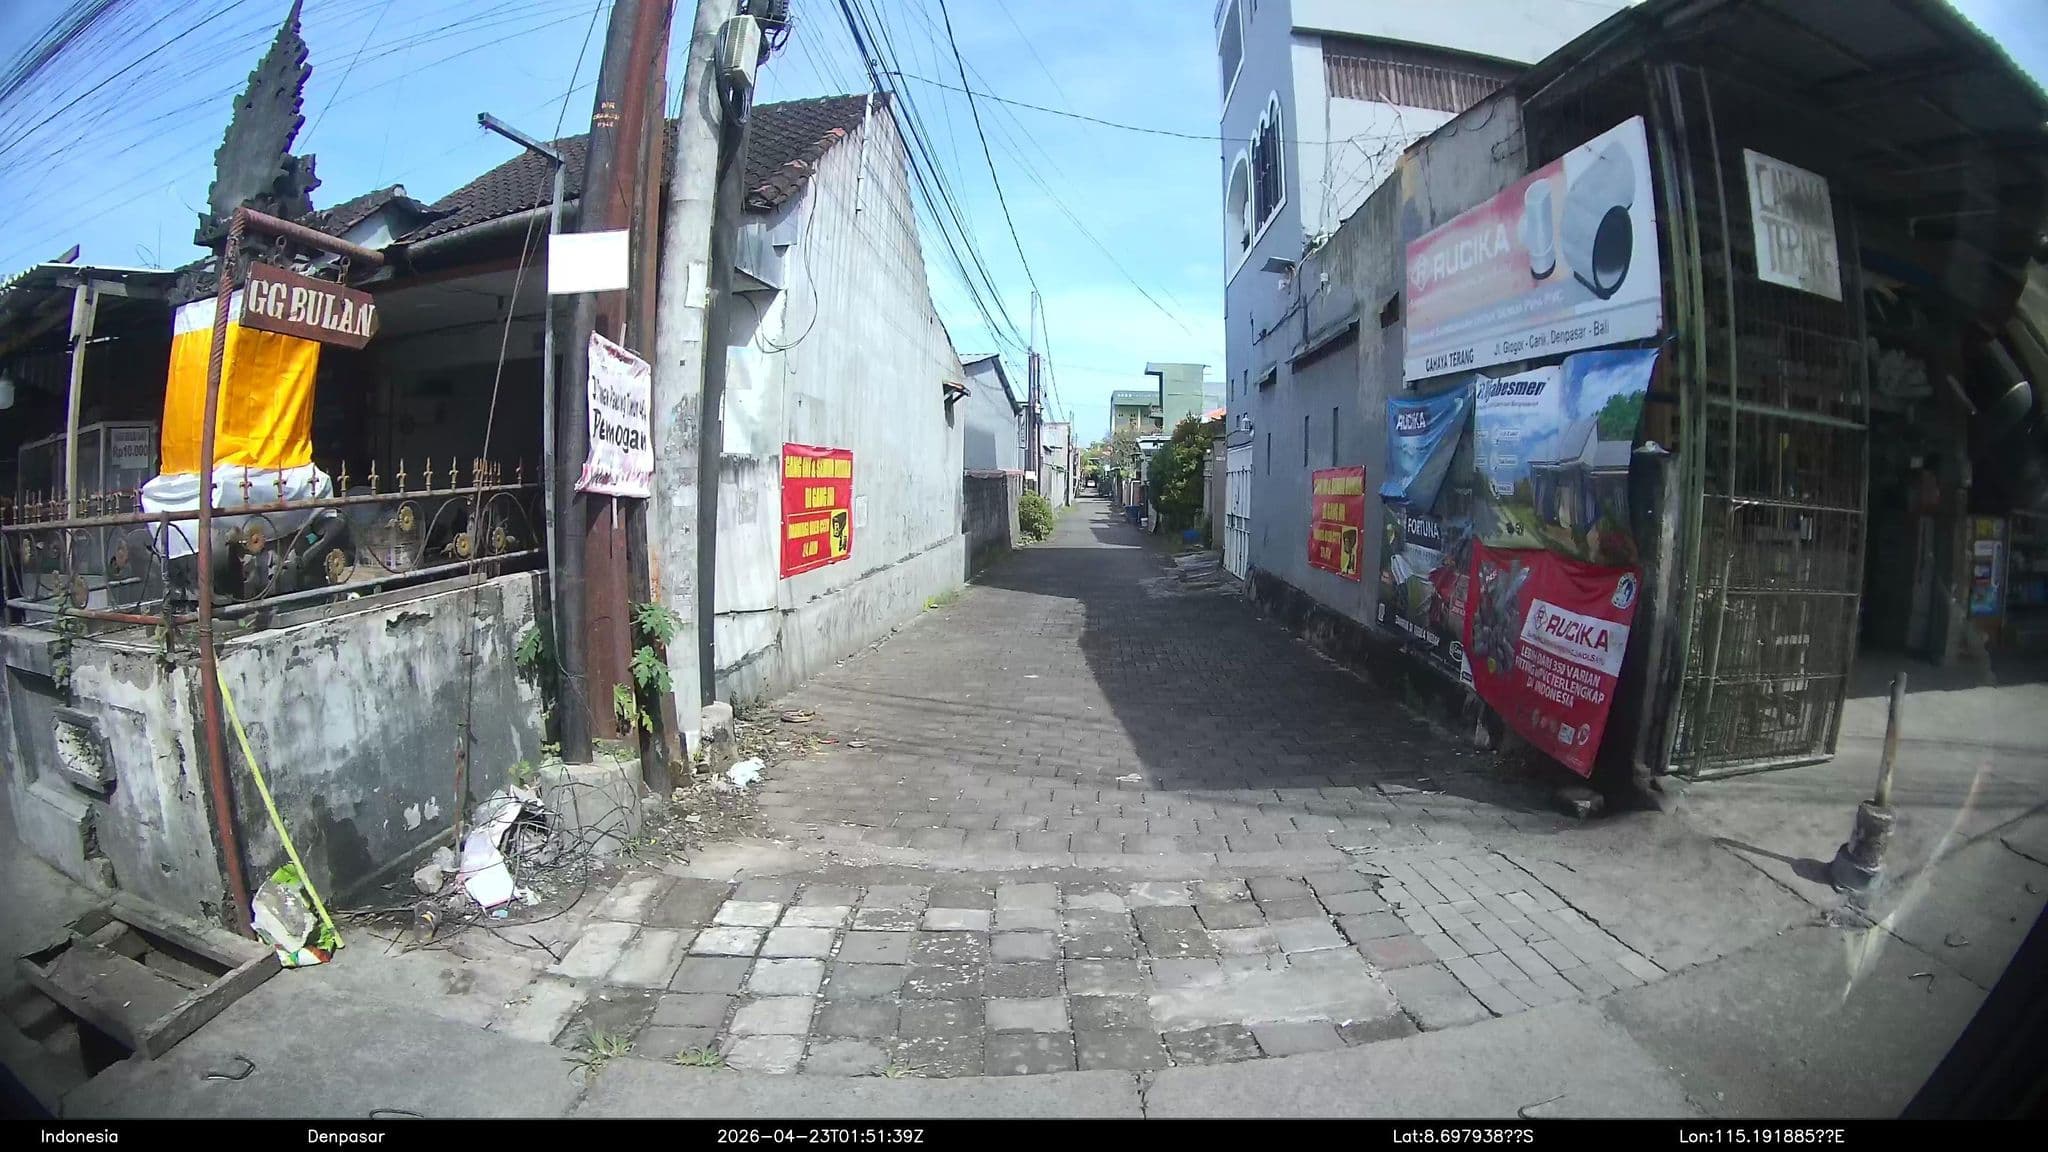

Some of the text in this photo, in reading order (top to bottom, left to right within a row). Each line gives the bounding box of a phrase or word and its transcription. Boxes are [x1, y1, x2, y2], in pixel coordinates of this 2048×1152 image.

[1433, 224, 1510, 281] RUCIKA
[248, 279, 376, 338] GG BULAN
[1551, 326, 1586, 344] Denpasar
[1593, 320, 1610, 337] Bali
[1425, 349, 1474, 372] CAHAYA TERANG
[593, 408, 647, 453] Pemogan
[1396, 411, 1427, 431] RUCIKA
[1407, 517, 1440, 540] FORTUNA
[1546, 614, 1609, 652] RUCIKA
[1521, 645, 1537, 662] LEBIH
[1567, 665, 1601, 689] VARIAN
[1535, 680, 1574, 709] INDONESIA
[1550, 673, 1605, 705] TERLENGKAP
